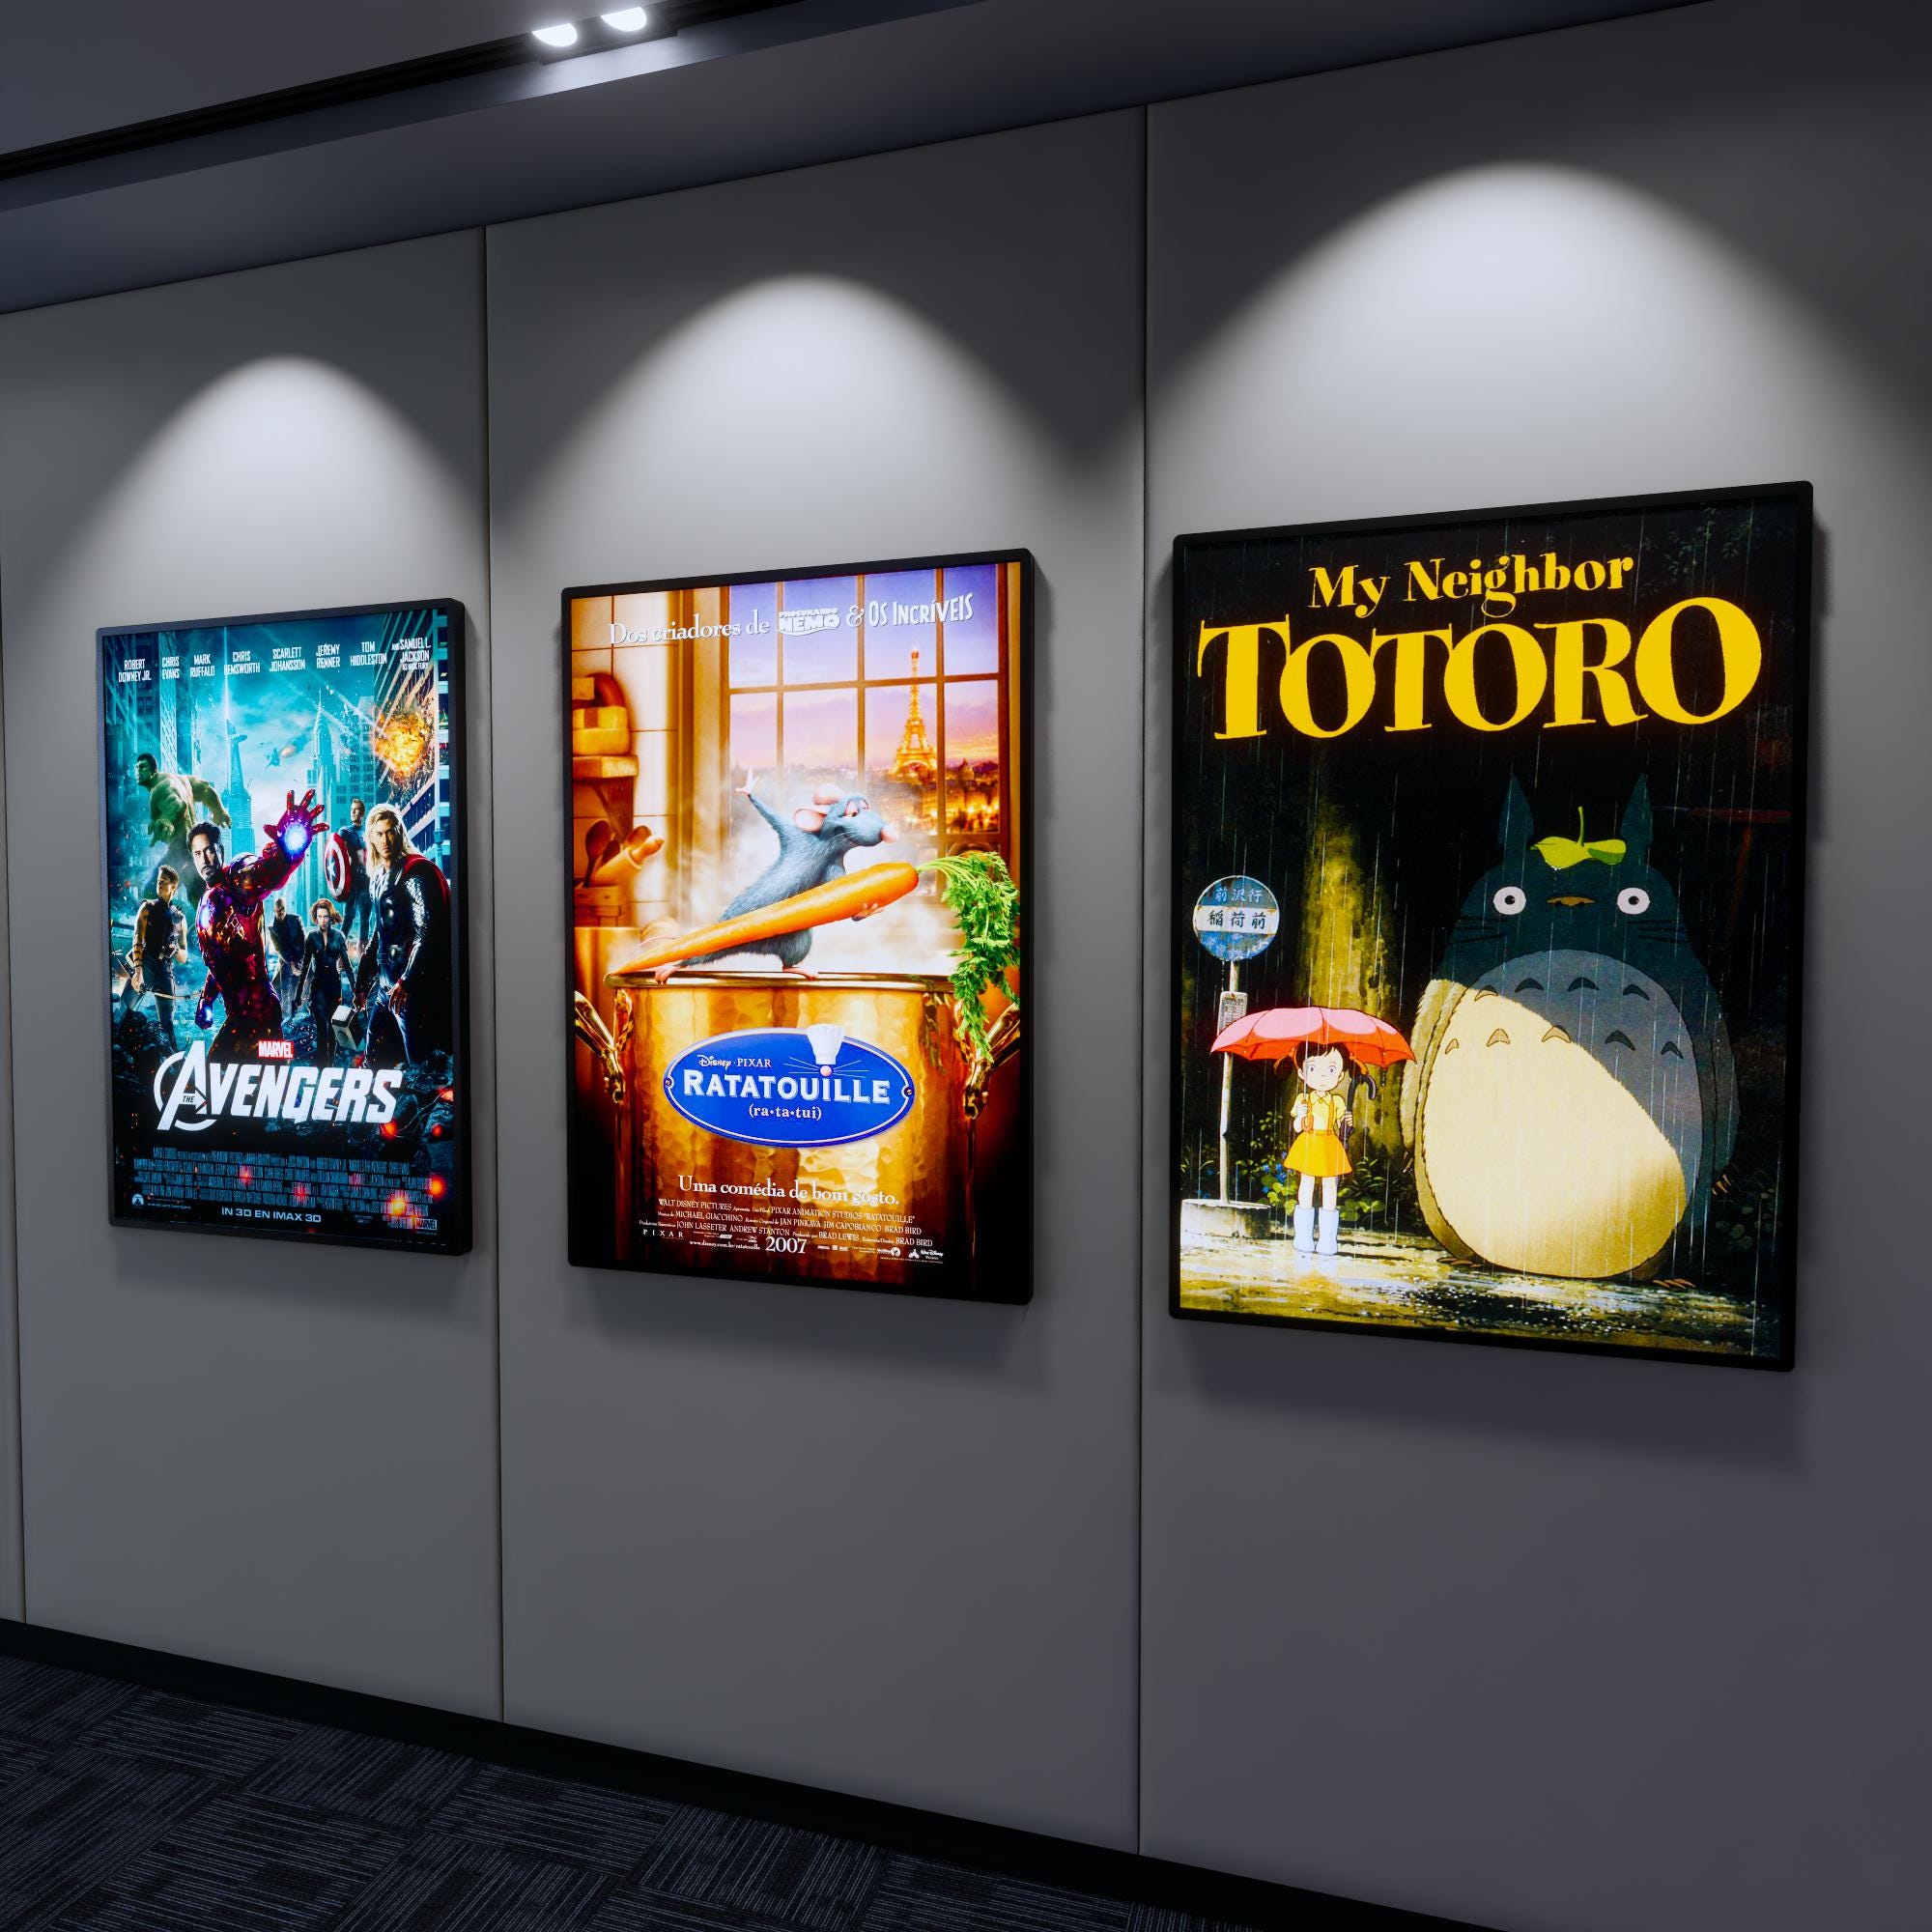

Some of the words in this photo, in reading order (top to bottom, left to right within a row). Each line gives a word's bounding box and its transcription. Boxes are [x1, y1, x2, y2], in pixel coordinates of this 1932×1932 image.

[1308, 564, 1391, 617] My
[1404, 553, 1634, 617] Neighbor
[779, 608, 838, 618] PROCURANDO
[846, 605, 865, 628] &
[610, 623, 648, 645] Dos
[653, 613, 741, 641] criadores
[746, 609, 771, 635] de
[778, 615, 840, 633] NEMO
[316, 643, 340, 657] JEREMY
[361, 641, 376, 653] TOM
[399, 638, 425, 650] SAMUEL
[193, 654, 211, 666] MARK
[232, 650, 251, 663] CHRIS
[272, 646, 302, 660] SCARLETT
[350, 653, 387, 667] HIDDLESTON
[399, 650, 430, 663] JACKSON
[124, 659, 146, 670] ROBERT
[162, 656, 180, 668] CHRIS
[269, 659, 306, 672] JOHANSSON
[317, 657, 340, 669] RENNER
[1198, 597, 1762, 740] TOTORO
[162, 668, 180, 680] EVANS
[190, 666, 215, 678] RUFFALO
[223, 663, 261, 676] HEMSWORTH
[118, 671, 141, 683] DOWNEY
[1208, 910, 1266, 929] 稲荷前
[258, 1040, 294, 1059] MARVEL
[696, 1054, 731, 1070] Disney
[736, 1058, 772, 1068] PIXAR
[155, 1039, 404, 1131] AVENGERS
[683, 1068, 891, 1104] RATATOUILLE
[183, 1095, 195, 1104] THE
[678, 1174, 719, 1193] Uma
[721, 1178, 785, 1198] comédia
[789, 1179, 808, 1200] de
[812, 1181, 849, 1202] bom
[852, 1190, 899, 1208] gosto.
[221, 1207, 234, 1216] IN
[235, 1208, 252, 1218] 3D
[255, 1209, 270, 1219] EN
[272, 1210, 302, 1221] IMAX
[304, 1213, 322, 1223] 3D
[659, 1198, 676, 1208] WALT
[676, 1200, 699, 1209] DISNEY
[700, 1202, 732, 1211] PICTURES
[771, 1207, 790, 1216] PIXAR
[792, 1208, 831, 1218] ANIMATION
[832, 1211, 863, 1221] STUDIOS
[675, 1210, 705, 1220] MICHAEL
[705, 1212, 743, 1223] GIACCHINO
[780, 1218, 792, 1227] JAN
[793, 1218, 821, 1229] PINKAVA
[823, 1221, 835, 1230] JIM
[836, 1222, 882, 1233] CAPOBIANCO
[884, 1225, 904, 1235] BRAD
[905, 1227, 923, 1236] BIRD
[676, 1221, 694, 1230] JOHN
[695, 1222, 727, 1232] LASSETER
[729, 1224, 757, 1234] ANDREW
[758, 1228, 790, 1236] STANTON
[818, 1232, 838, 1241] BRAD
[838, 1233, 860, 1242] LEWIS
[895, 1237, 915, 1246] BRAD
[765, 1236, 808, 1254] 2007
